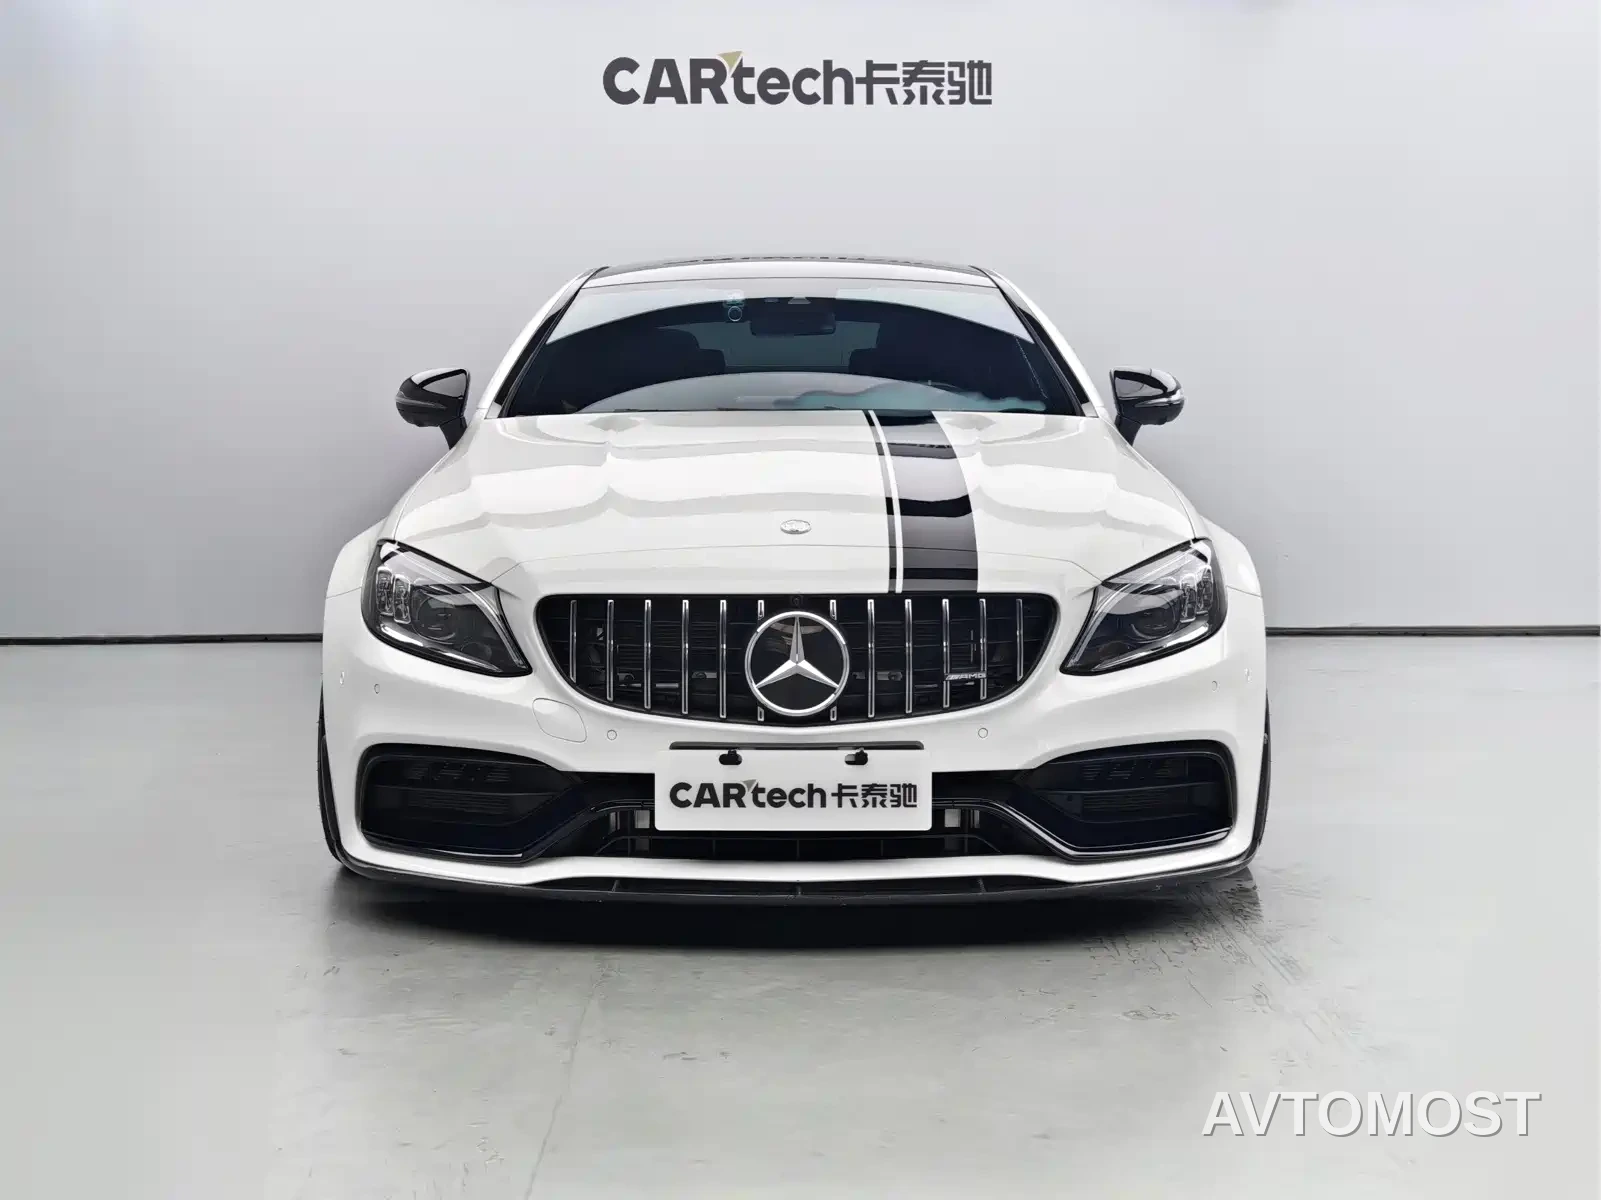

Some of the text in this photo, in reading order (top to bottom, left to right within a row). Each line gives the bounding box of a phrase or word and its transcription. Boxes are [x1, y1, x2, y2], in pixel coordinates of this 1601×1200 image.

[603, 52, 993, 106] CARtech 卡泰驰
[669, 779, 918, 809] CARtech 卡泰驰
